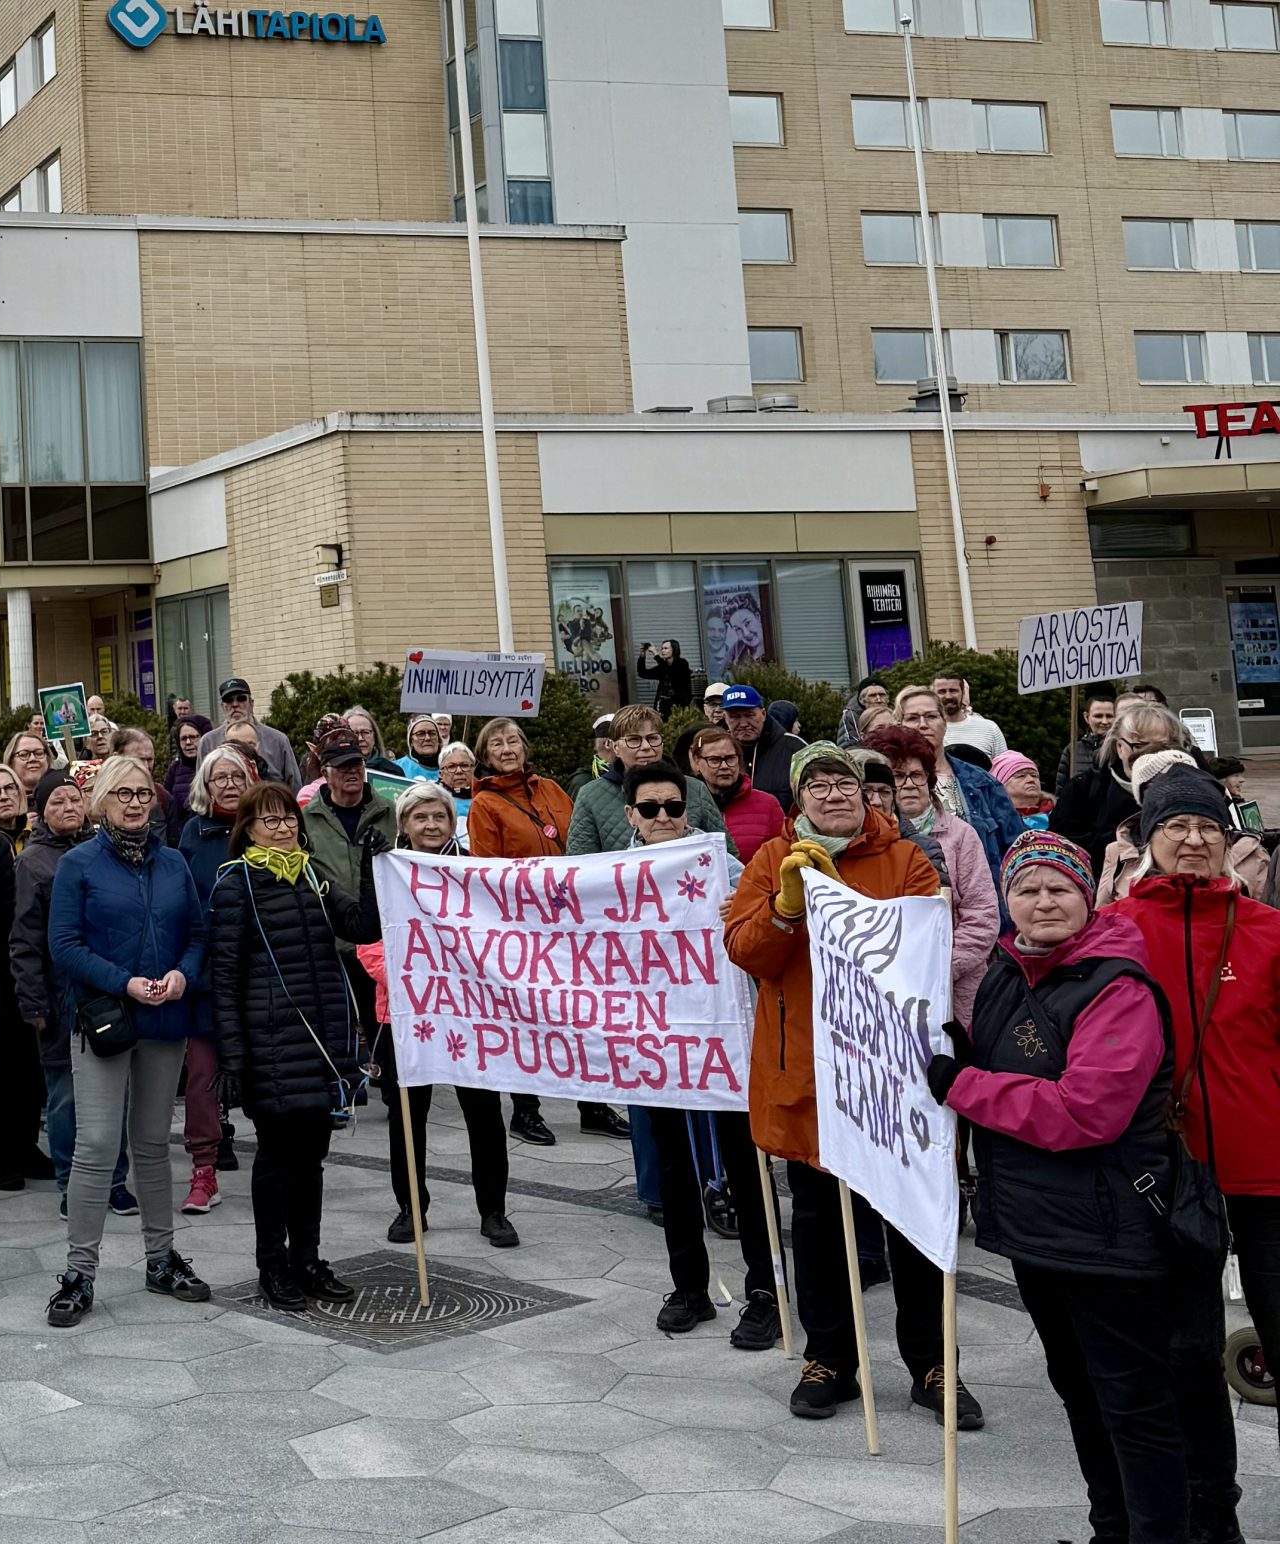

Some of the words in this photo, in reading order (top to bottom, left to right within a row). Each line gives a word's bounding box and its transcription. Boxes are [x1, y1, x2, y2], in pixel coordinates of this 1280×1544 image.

[175, 0, 387, 43] LÄHITAPIOLA
[1183, 401, 1280, 439] TEA
[1032, 605, 1129, 652] ARVOSTA
[407, 667, 536, 697] INHIMILLISYYTTÄ
[1021, 639, 1140, 688] OMAISHOITOA
[410, 857, 584, 924] HYVÄN
[603, 859, 669, 923] JA
[403, 918, 719, 986] ARVOKKAAN
[400, 974, 671, 1033] VANHUUDEN
[472, 1023, 743, 1092] PUOLESTA
